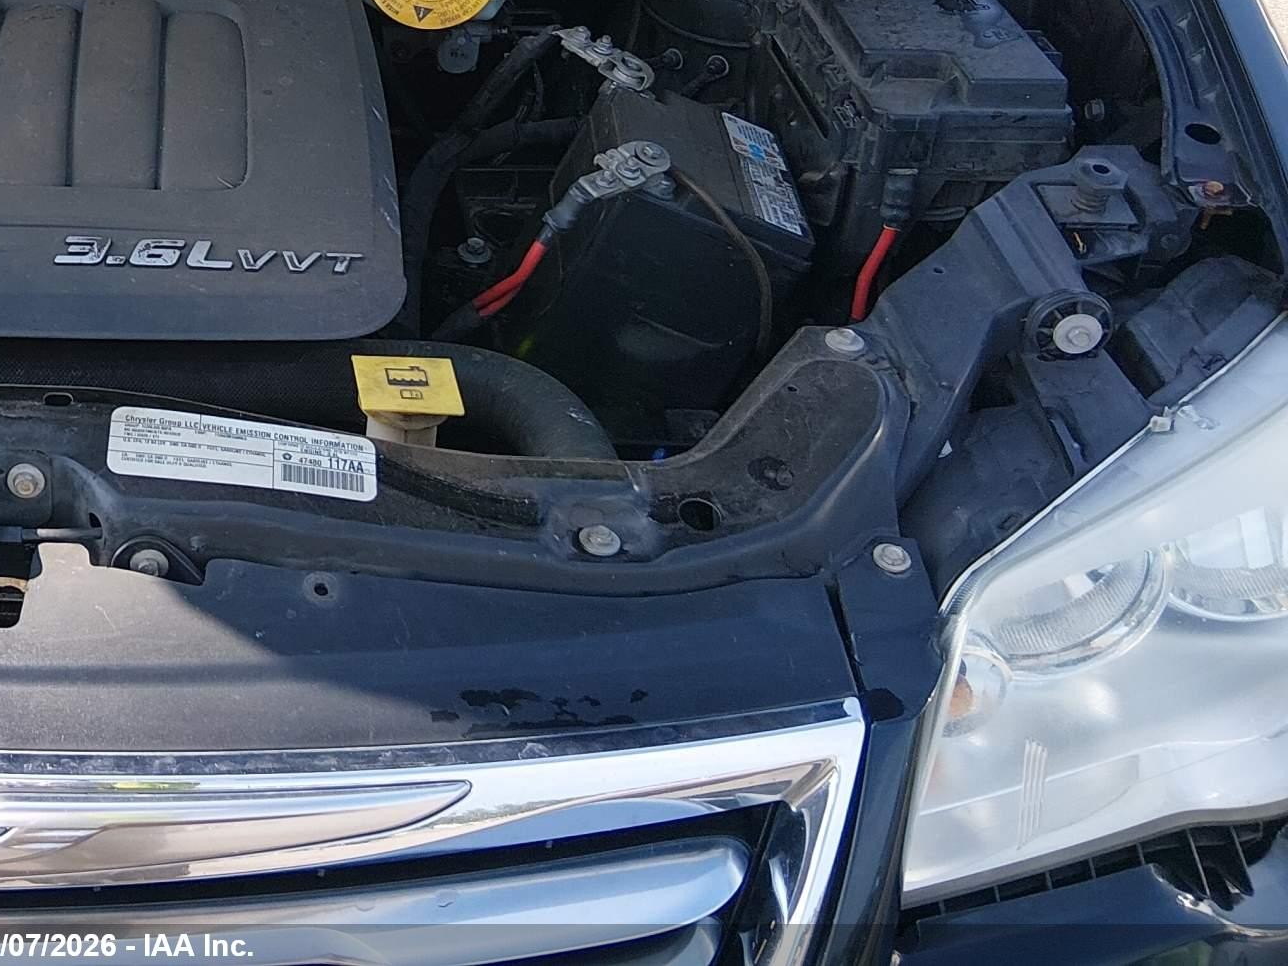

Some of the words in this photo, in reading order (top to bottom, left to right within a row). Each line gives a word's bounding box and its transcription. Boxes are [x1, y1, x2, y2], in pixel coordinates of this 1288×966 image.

[236, 248, 364, 274] VVT
[125, 414, 157, 424] Chrysler
[159, 417, 182, 427] Group
[184, 419, 199, 429] LLC
[202, 422, 233, 434] VEHICLE
[235, 427, 271, 438] EMISSION
[273, 432, 308, 444] CONTROL
[311, 438, 364, 451] INFORMATION
[327, 457, 365, 473] 117AA
